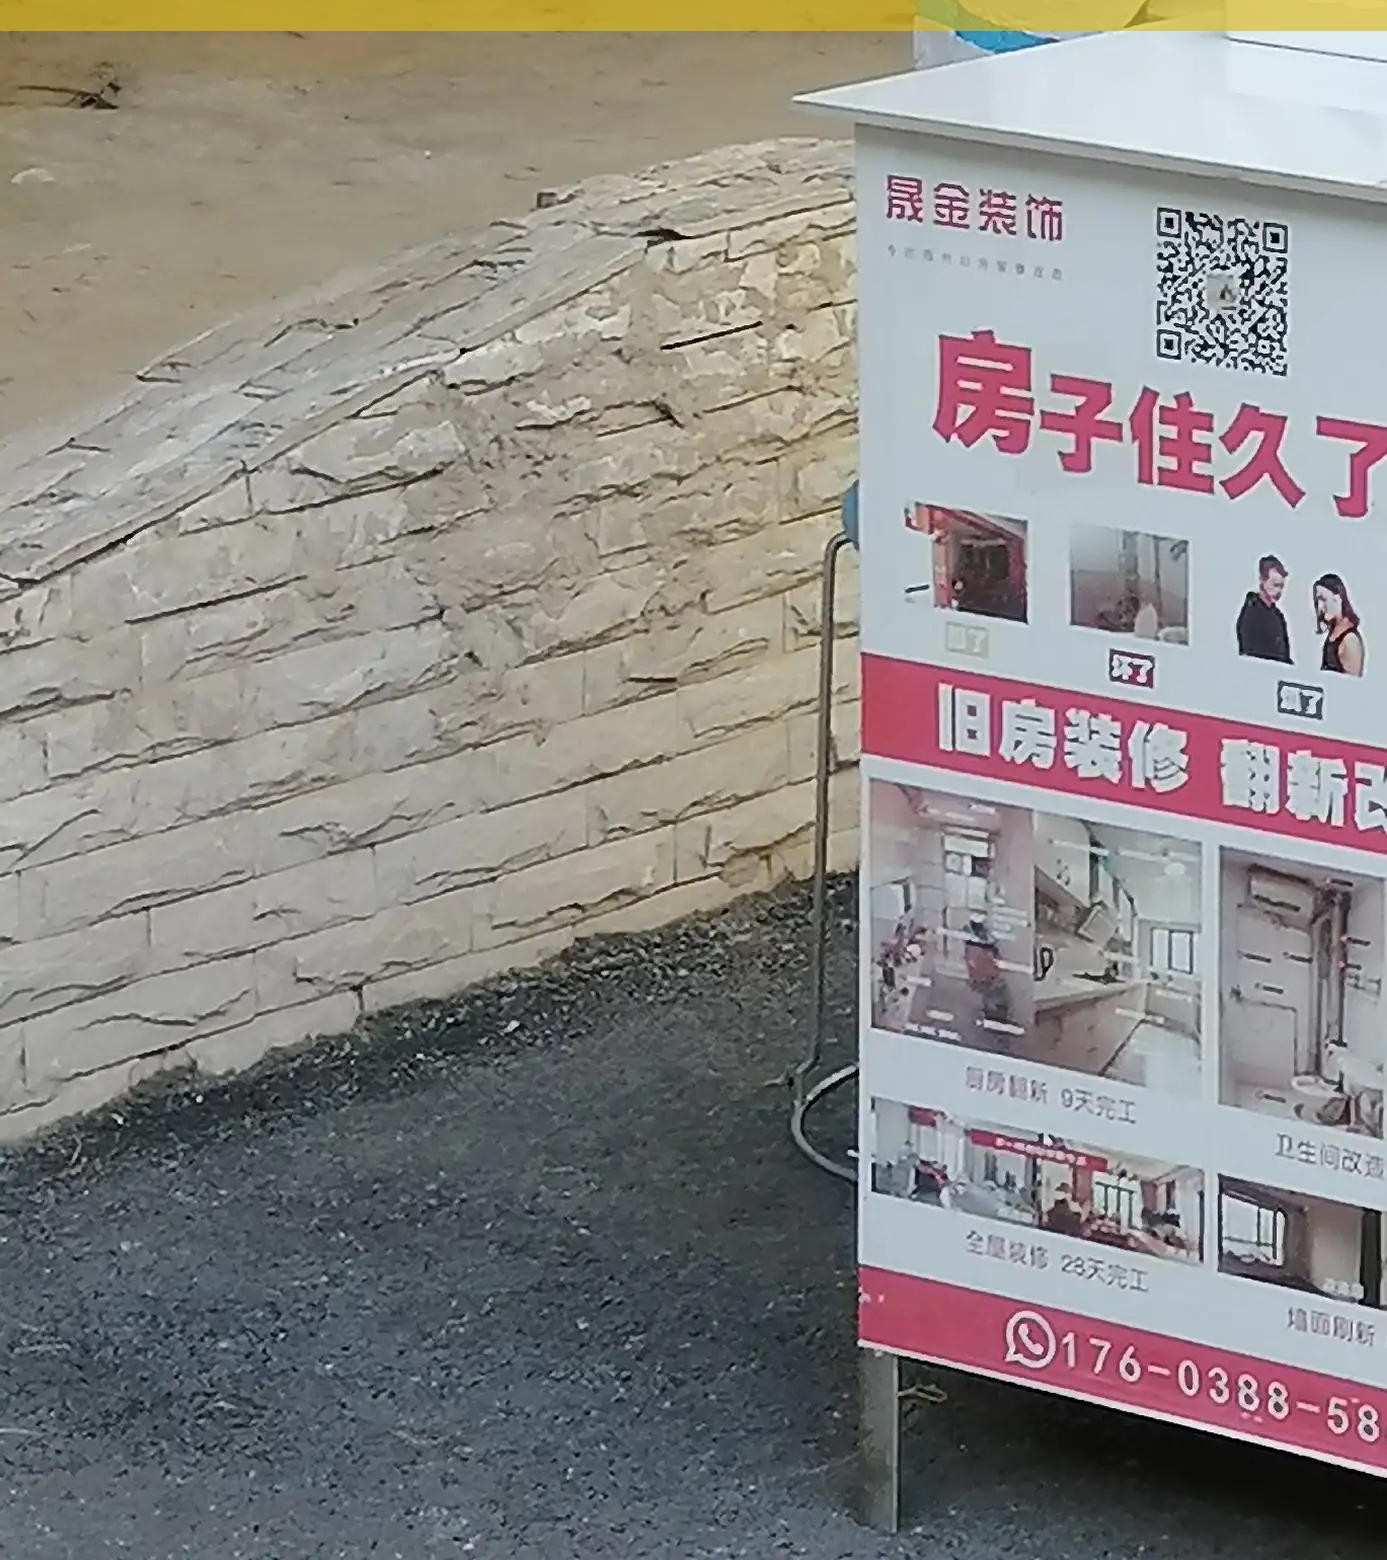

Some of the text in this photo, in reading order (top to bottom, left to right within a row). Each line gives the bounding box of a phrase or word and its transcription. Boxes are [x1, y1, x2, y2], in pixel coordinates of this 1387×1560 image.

[886, 174, 1063, 242] 晟金装饰
[937, 682, 1190, 794] 旧房装修
[1060, 1088, 1137, 1124] 9天完工
[1275, 1132, 1385, 1181] 卫生间改造
